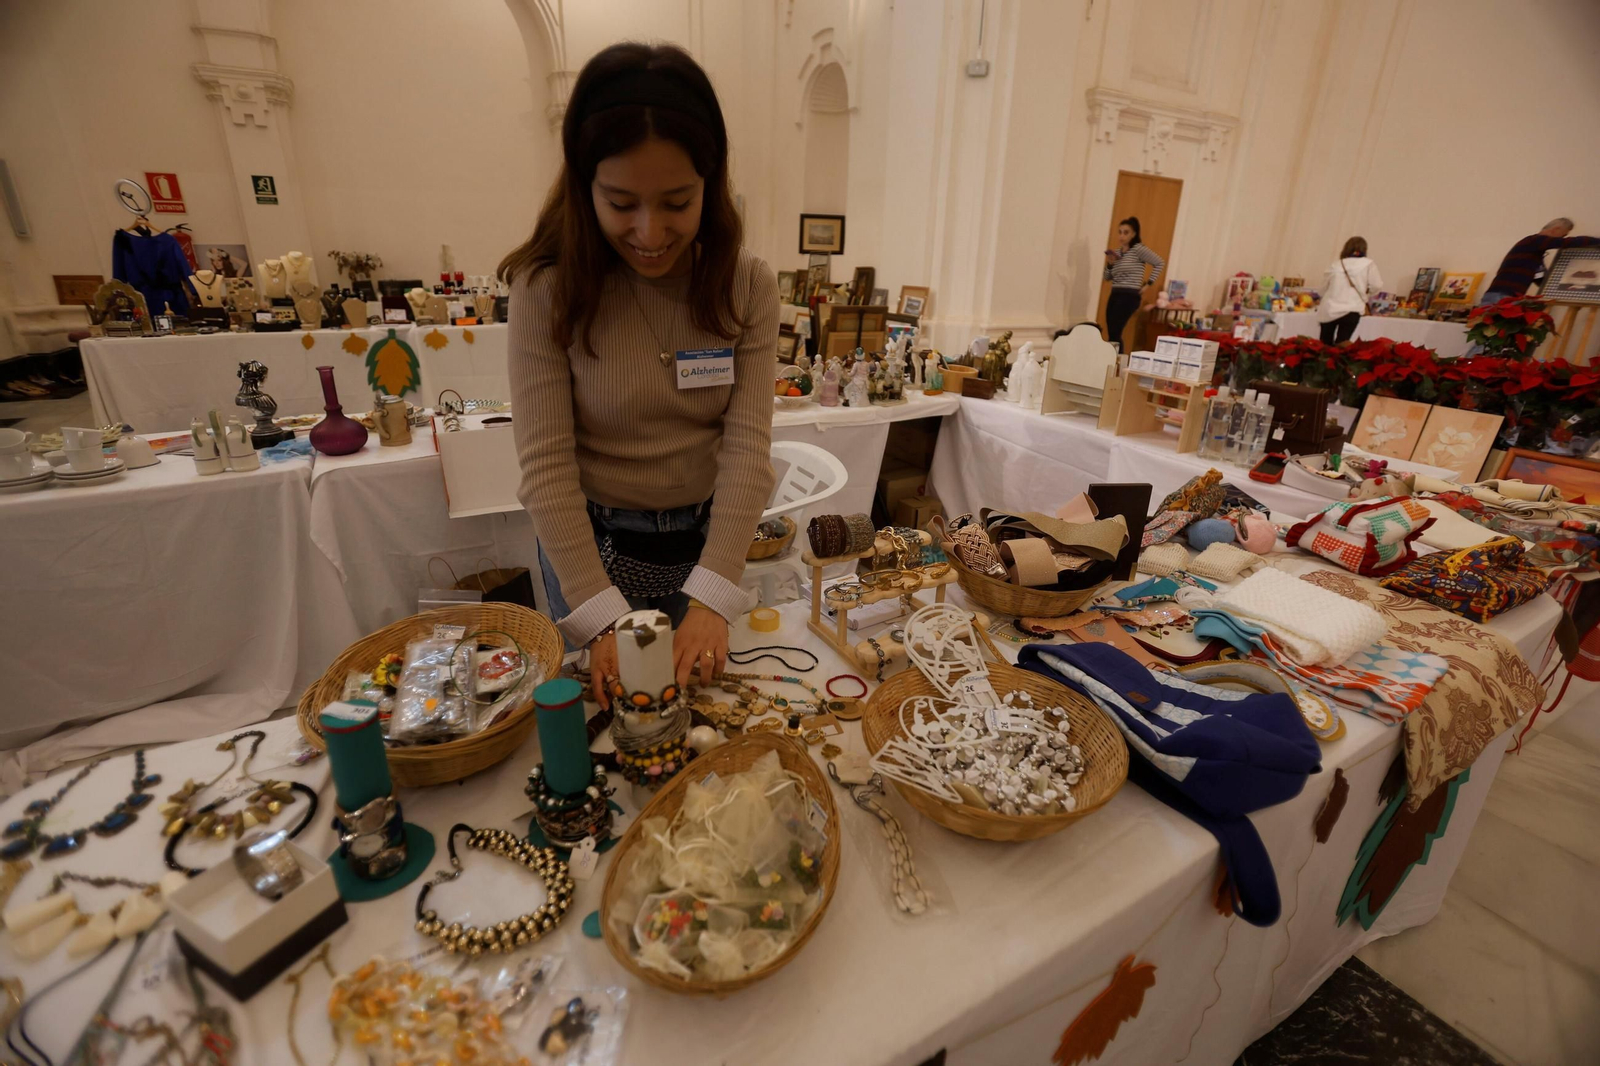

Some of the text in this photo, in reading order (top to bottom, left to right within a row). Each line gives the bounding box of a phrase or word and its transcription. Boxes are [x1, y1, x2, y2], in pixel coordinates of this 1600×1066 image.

[155, 204, 184, 212] EXTINTOR
[690, 366, 731, 376] Alzheimer
[437, 632, 448, 640] 2€
[965, 685, 975, 693] 2€
[1000, 721, 1009, 730] 2€
